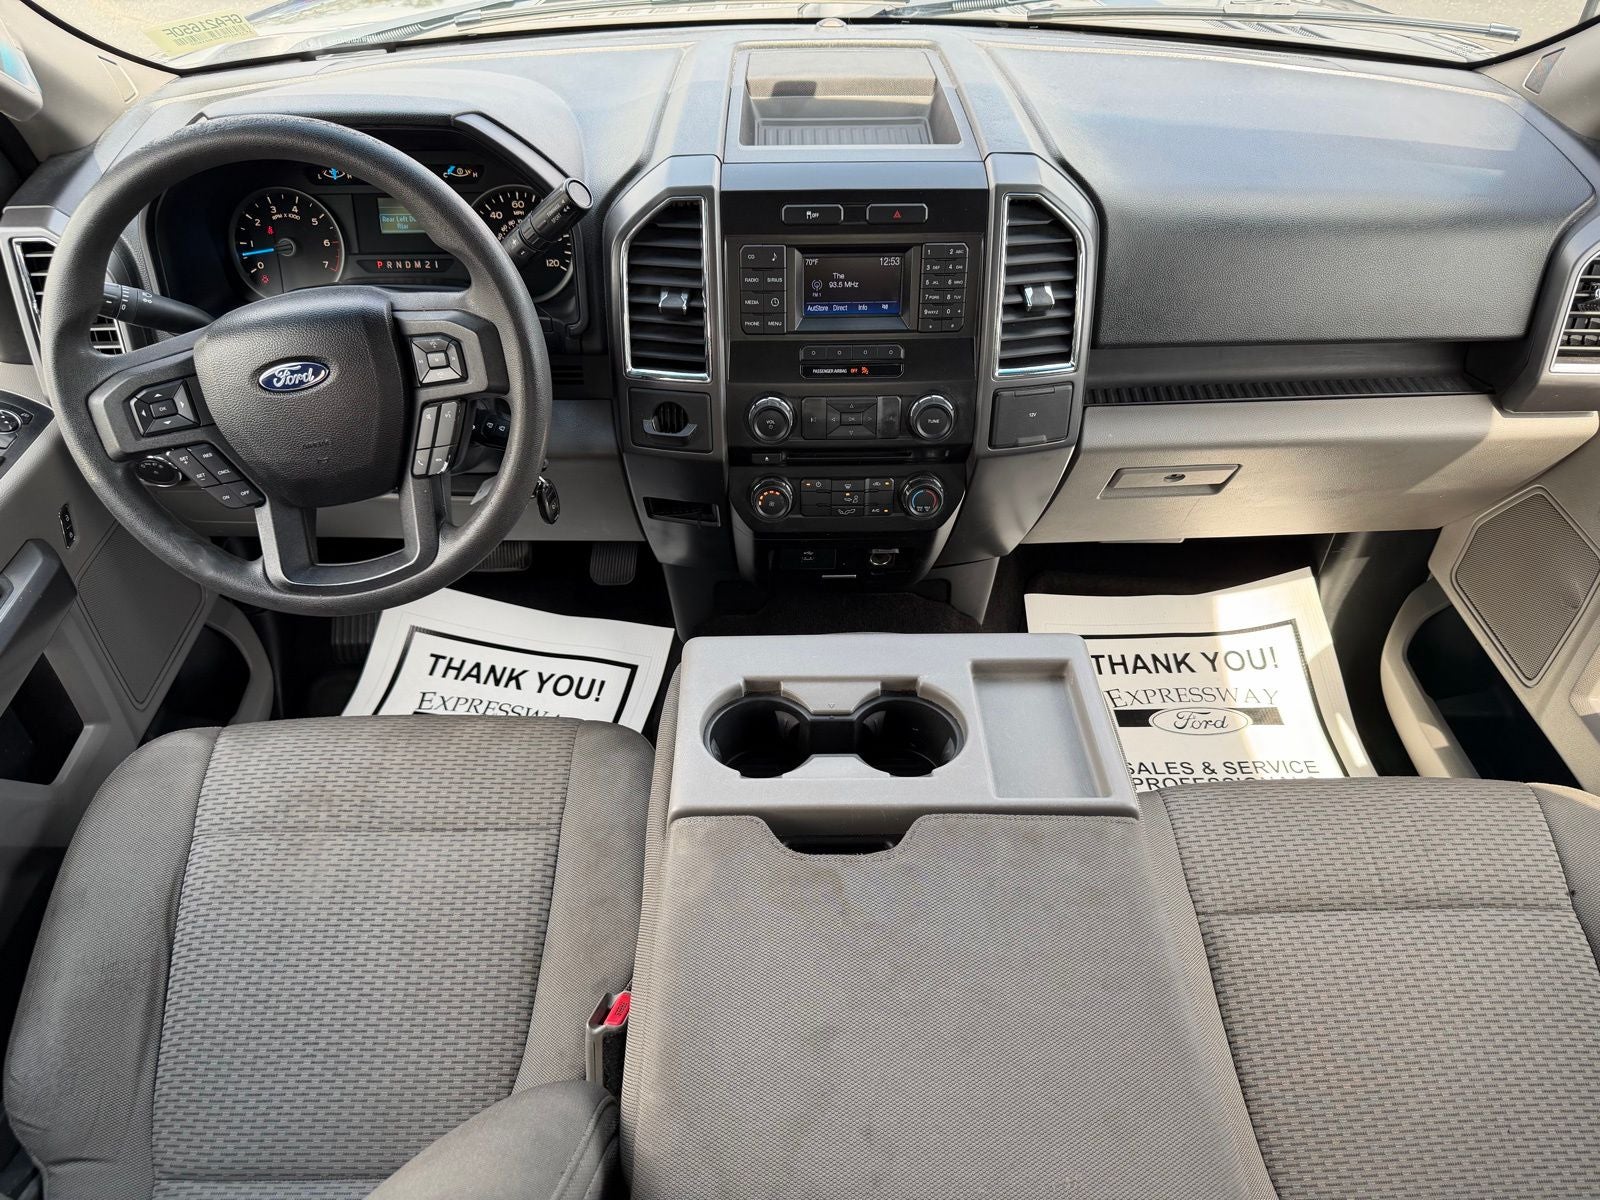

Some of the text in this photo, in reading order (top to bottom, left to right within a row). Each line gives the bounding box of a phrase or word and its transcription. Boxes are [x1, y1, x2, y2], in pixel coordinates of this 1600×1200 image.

[511, 200, 525, 209] 60
[270, 206, 277, 214] 3
[490, 211, 503, 219] 40
[311, 218, 319, 226] 5
[250, 240, 254, 248] 1
[323, 239, 331, 247] 6
[257, 261, 265, 269] 0
[322, 261, 329, 269] 7
[546, 259, 560, 267] 120
[880, 257, 900, 266] 12:53
[832, 272, 845, 280] The
[272, 365, 315, 387] Ford
[1091, 646, 1279, 675] THANK YOU!
[428, 653, 606, 702] THANK YOU!
[1104, 686, 1279, 709] EXPRESSWAY
[417, 691, 561, 717] EXPRESSW
[1173, 711, 1229, 730] Ford
[1126, 760, 1320, 775] SALES & SERVICE
